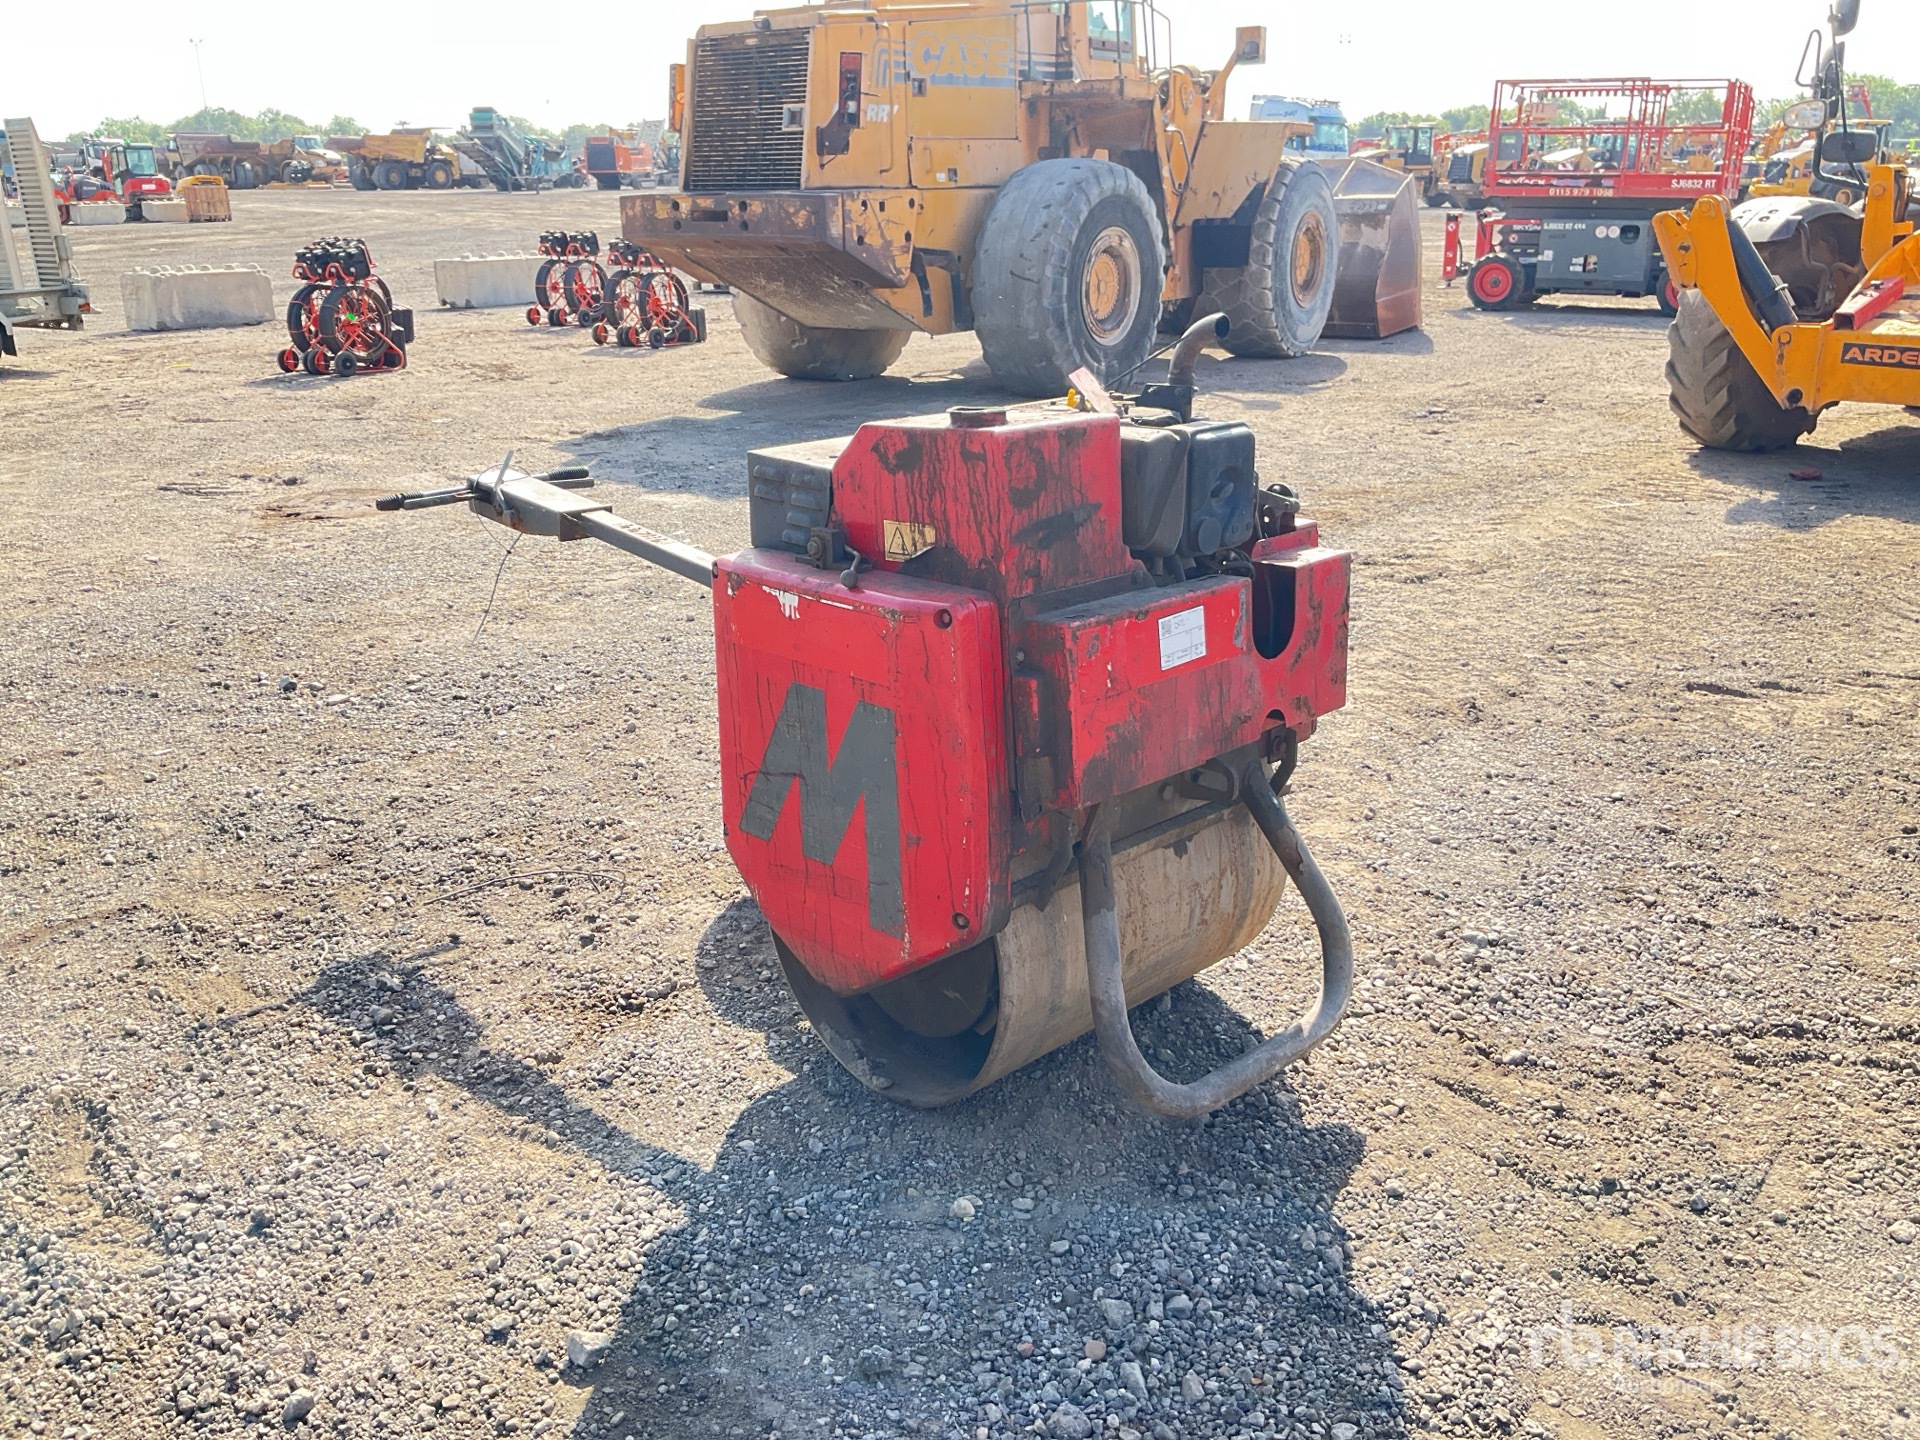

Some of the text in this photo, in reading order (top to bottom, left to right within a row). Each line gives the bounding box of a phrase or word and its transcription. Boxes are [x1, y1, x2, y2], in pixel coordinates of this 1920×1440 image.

[912, 31, 1011, 78] CASE
[1549, 187, 1570, 196] 0115
[1671, 179, 1717, 188] SJ6832 RT
[1844, 346, 1920, 366] ARDE
[739, 682, 905, 940] M
